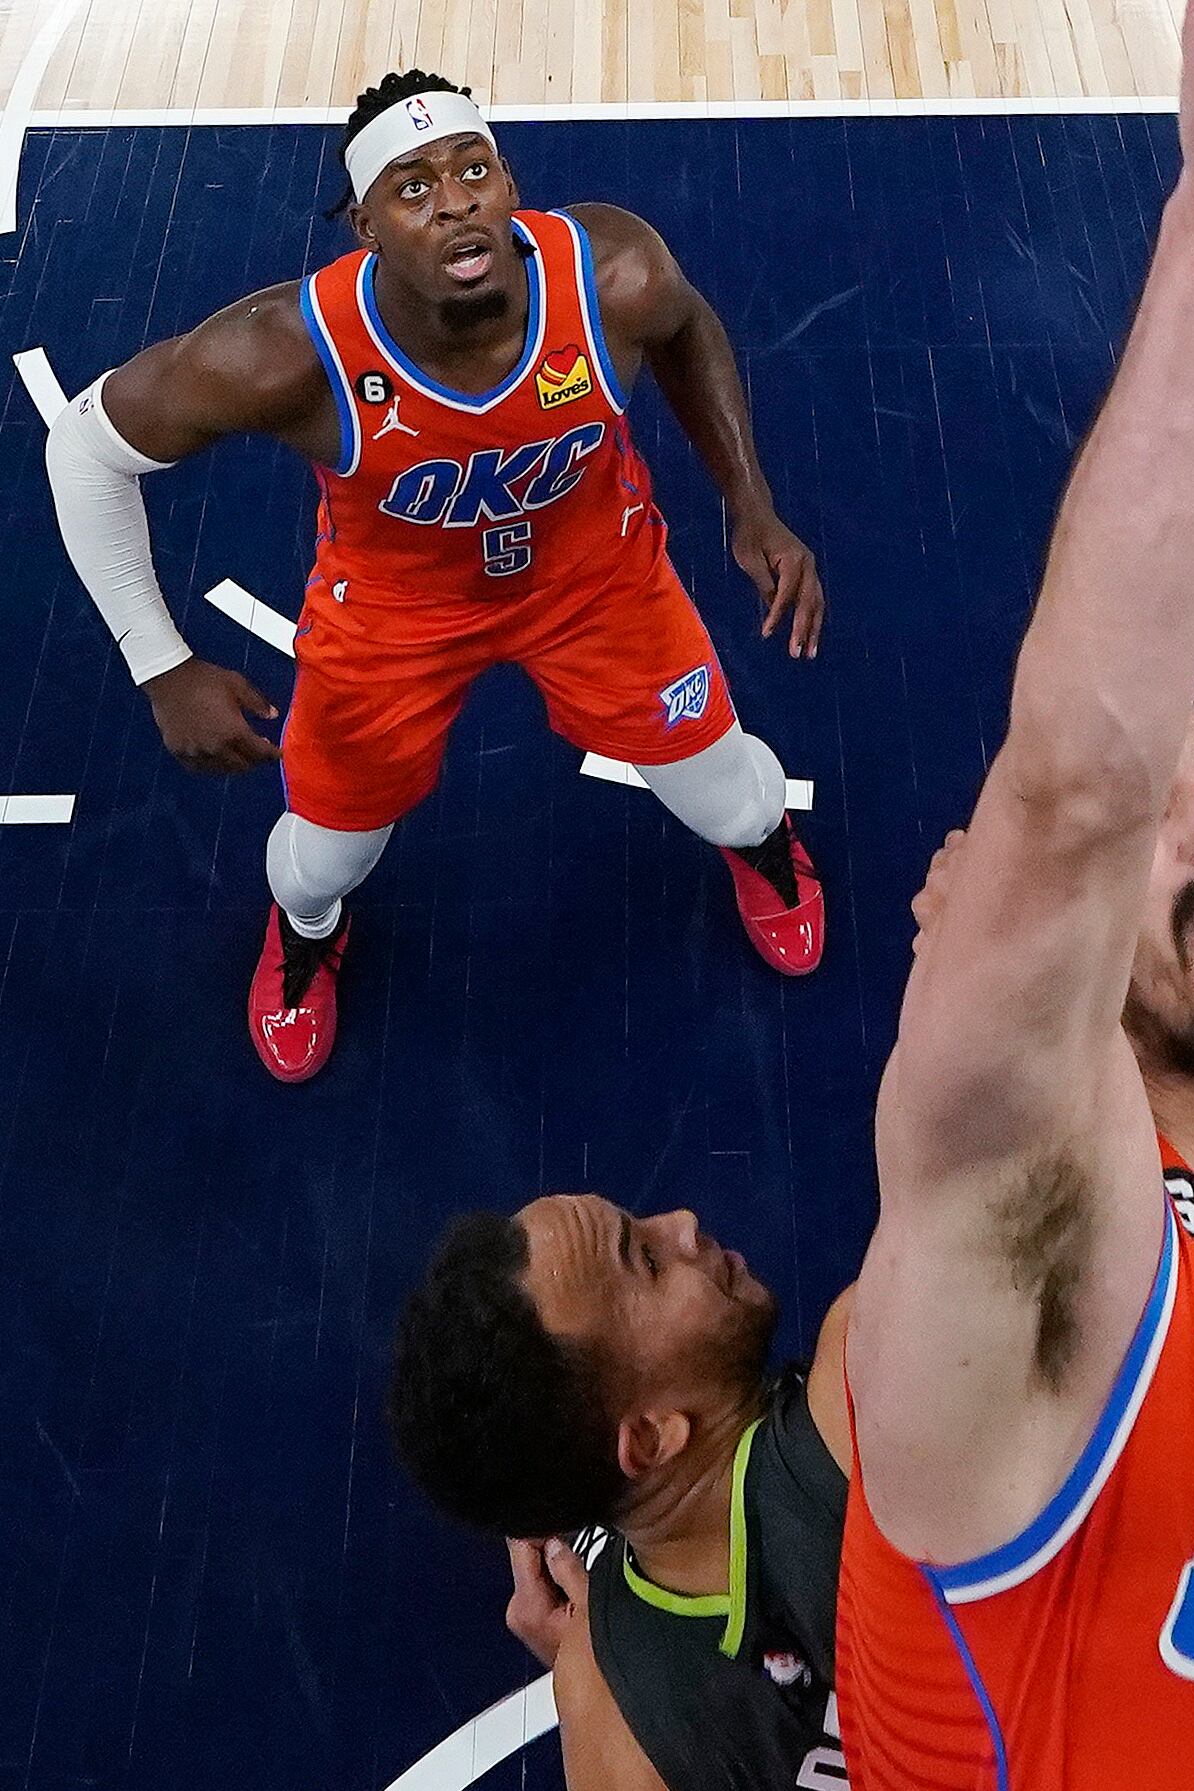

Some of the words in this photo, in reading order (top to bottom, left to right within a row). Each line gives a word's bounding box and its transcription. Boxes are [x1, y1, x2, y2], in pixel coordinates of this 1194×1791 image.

[364, 375, 386, 401] 6
[379, 421, 604, 528] OKC
[482, 521, 532, 576] 5
